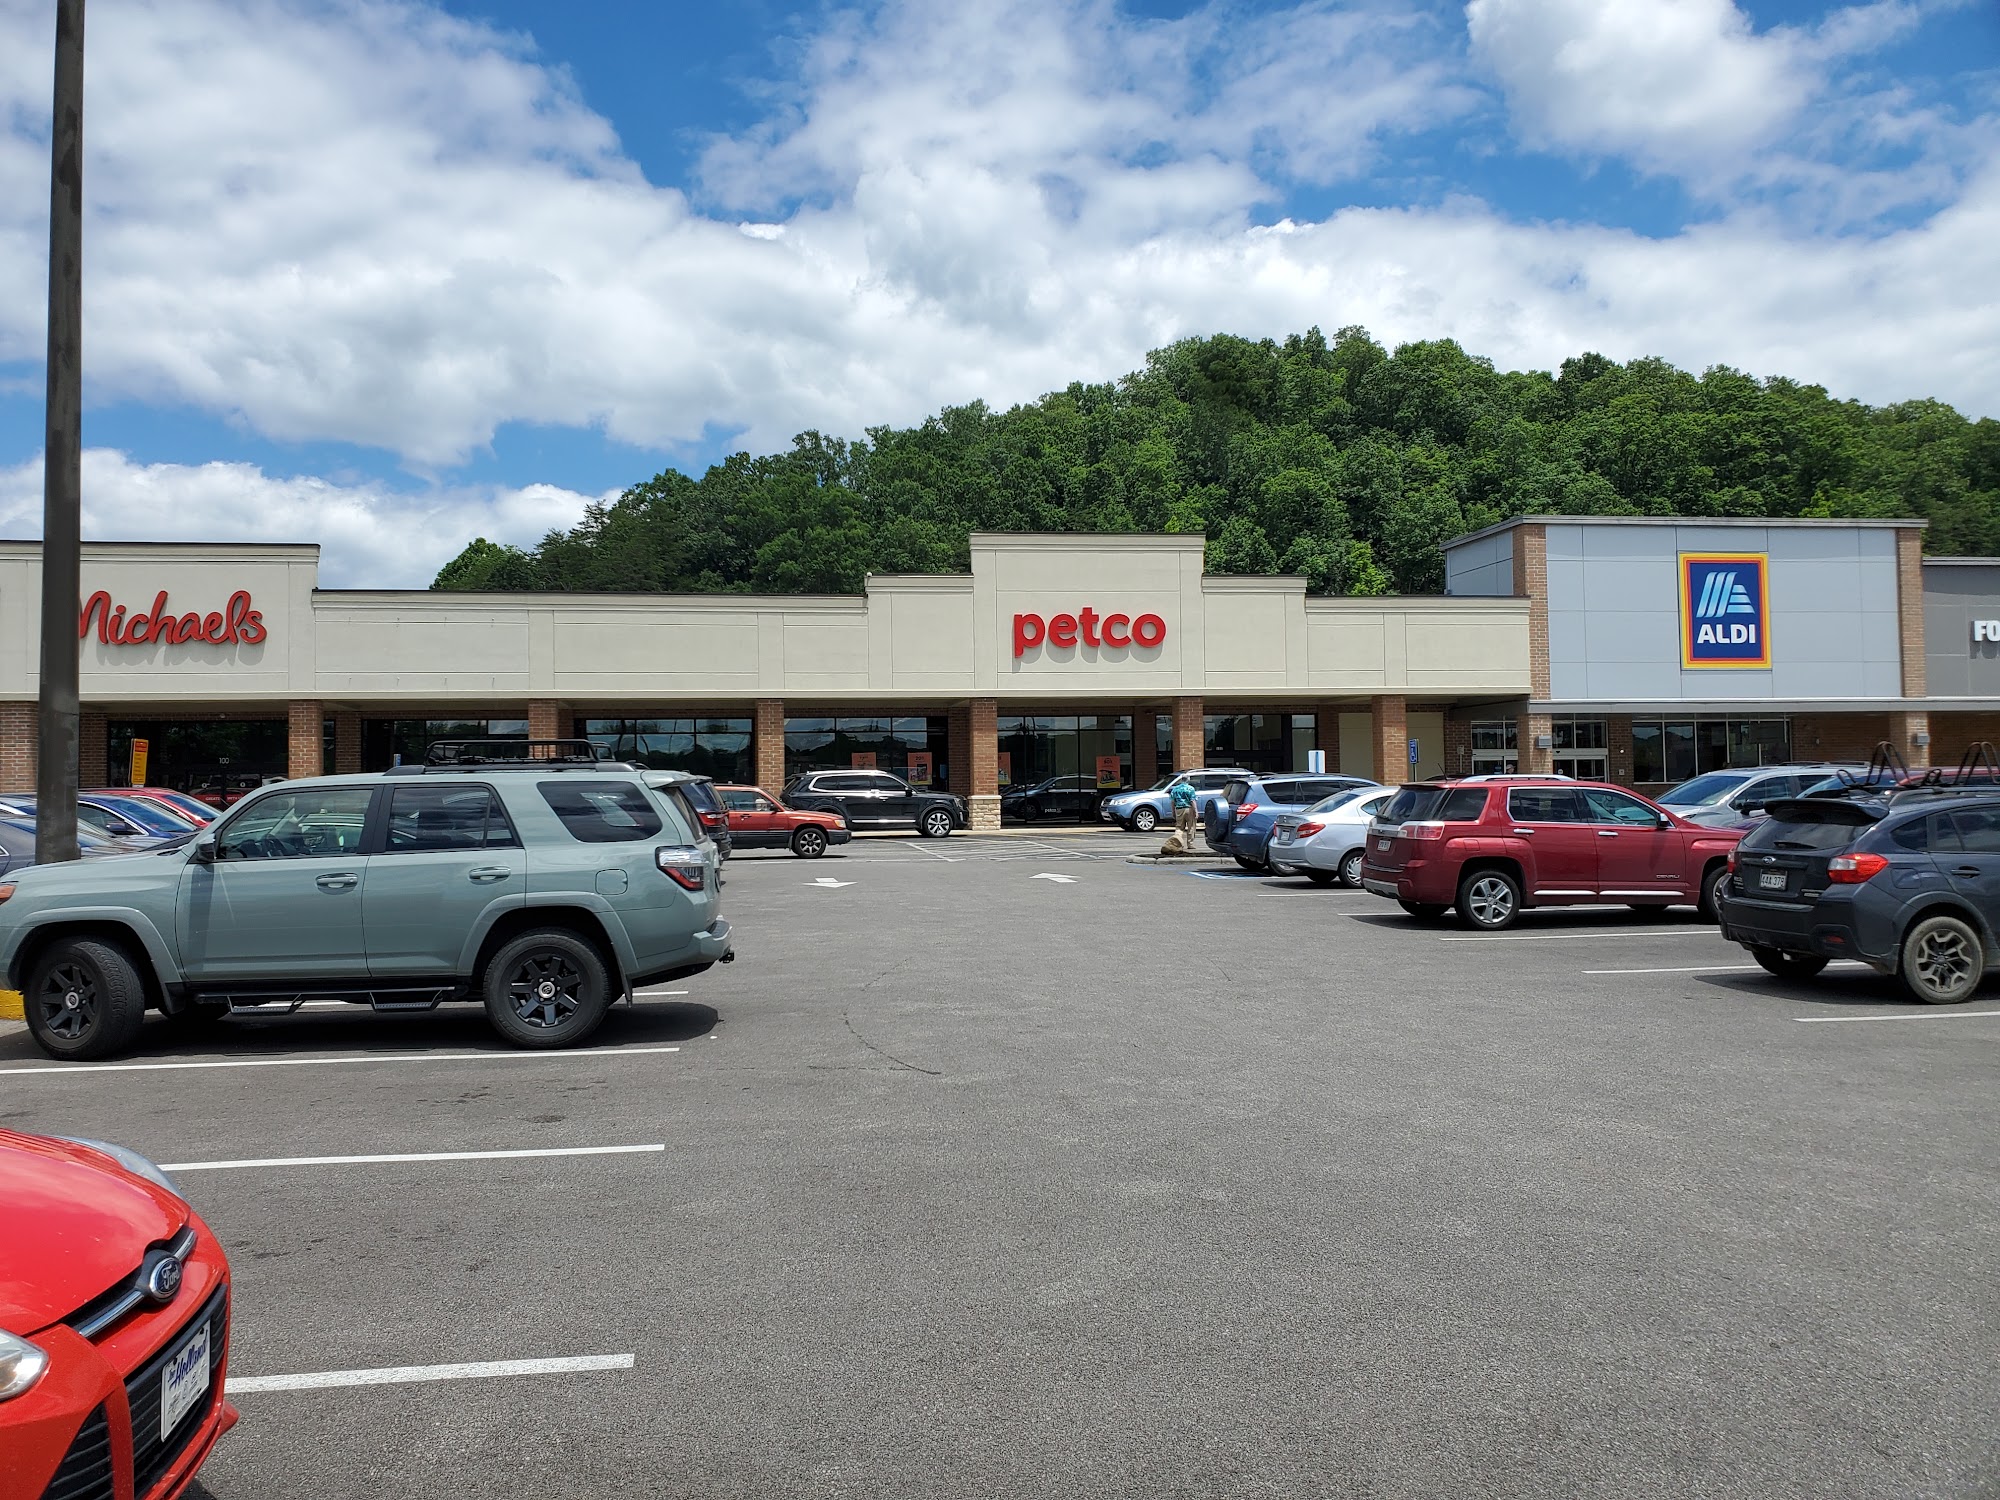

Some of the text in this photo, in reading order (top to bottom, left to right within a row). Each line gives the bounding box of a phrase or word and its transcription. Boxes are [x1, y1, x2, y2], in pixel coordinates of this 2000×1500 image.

[1014, 607, 1166, 658] petco
[1697, 624, 1756, 643] ALDI
[162, 1264, 180, 1290] Ford
